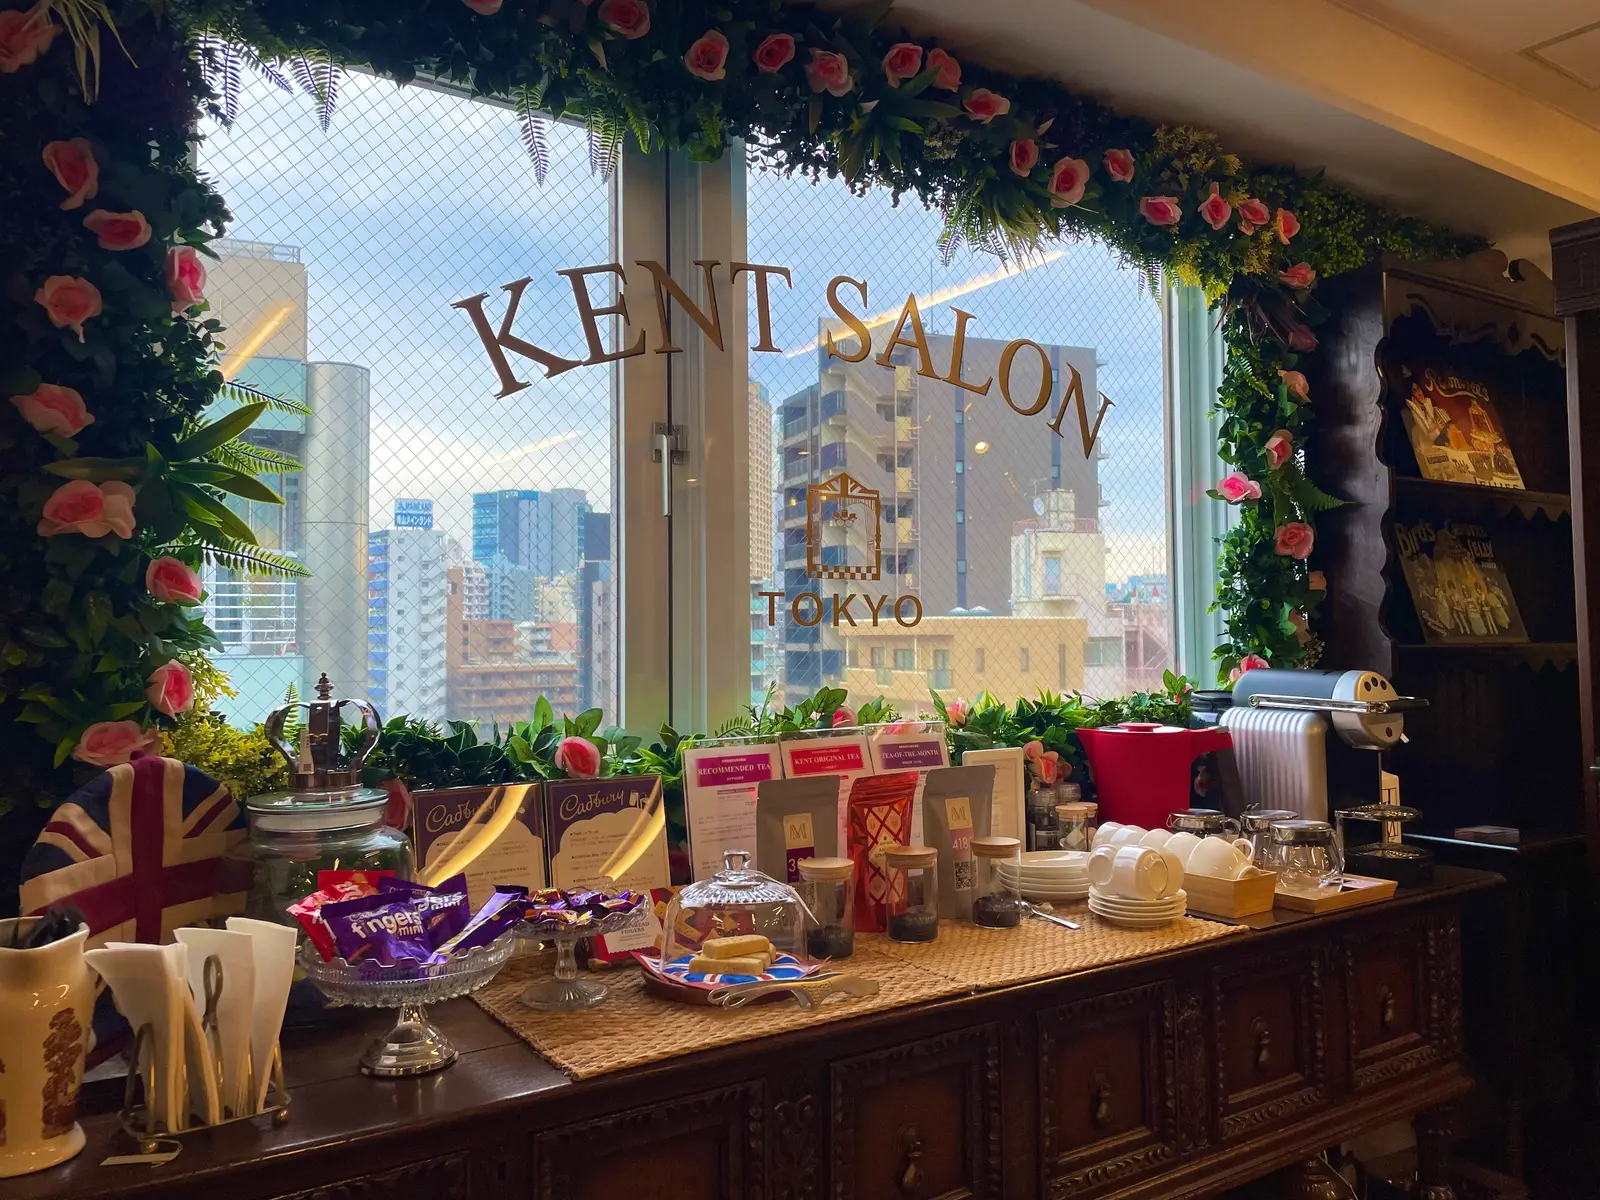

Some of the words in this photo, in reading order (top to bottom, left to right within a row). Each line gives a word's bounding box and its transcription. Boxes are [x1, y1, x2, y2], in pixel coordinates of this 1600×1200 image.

[450, 260, 792, 400] KENT
[825, 275, 1116, 460] SALON
[758, 591, 923, 628] TOKYO
[794, 757, 815, 765] KENT
[814, 754, 846, 764] ORIGINAL
[847, 753, 860, 761] TEA
[882, 749, 939, 759] TEA-OF-THE-MONTH
[698, 764, 754, 776] RECOMMENDED
[756, 763, 772, 771] TEA
[559, 789, 625, 821] Cadbury
[425, 799, 497, 833] Cadby
[952, 836, 972, 851] 418
[350, 911, 422, 939] fingers
[398, 924, 424, 937] mini
[621, 927, 645, 935] FINGERS
